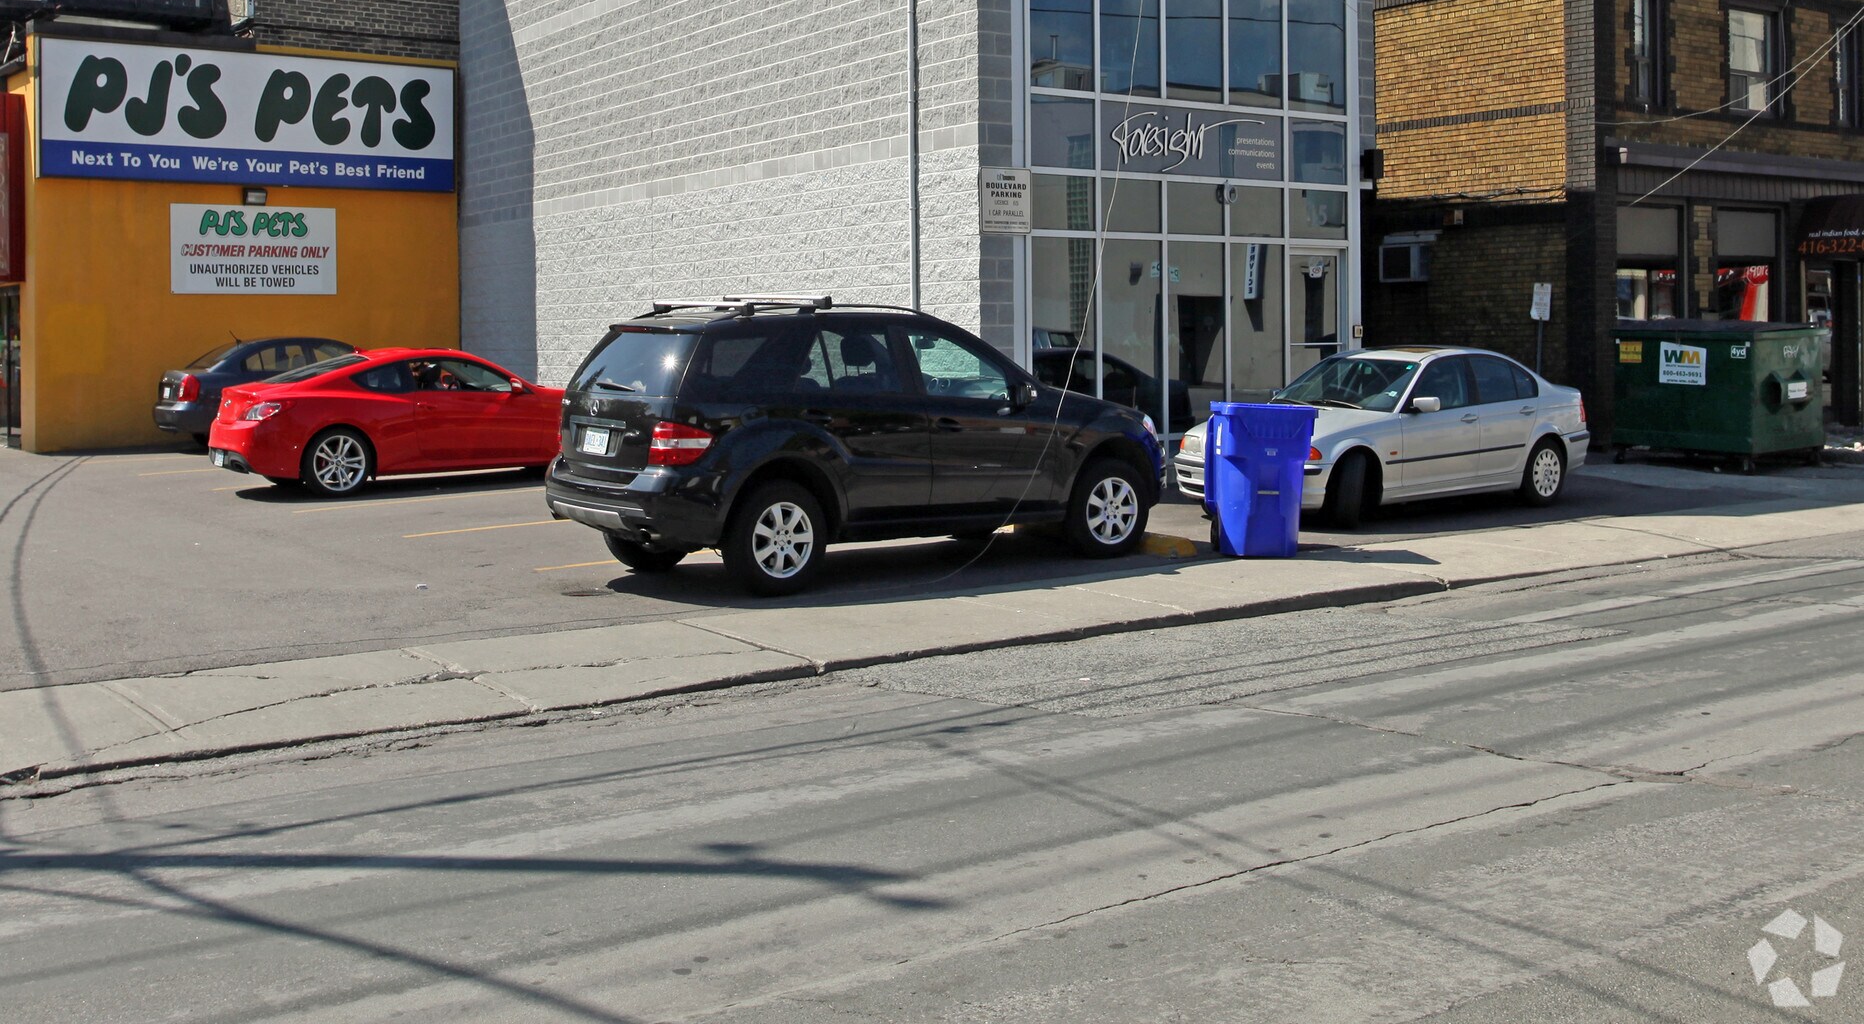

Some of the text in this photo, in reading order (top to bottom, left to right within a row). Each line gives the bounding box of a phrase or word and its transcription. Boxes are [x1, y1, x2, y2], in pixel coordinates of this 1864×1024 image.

[63, 53, 436, 151] PJ'S PETS
[1111, 111, 1266, 173] Foresight
[1236, 136, 1275, 147] presentations
[1227, 148, 1275, 158] communications
[71, 150, 425, 179] Next To You We're Your Pet's Best Friend
[1256, 161, 1275, 170] events
[985, 182, 1027, 190] BOULEVARD
[199, 209, 309, 238] PJ'S PETS
[1808, 230, 1821, 238] real
[1821, 229, 1843, 237] indian
[181, 244, 330, 259] CUSTOMER PARKING ONLY
[189, 263, 319, 275] UNAUTHORIZED VEHICLES
[215, 277, 295, 288] WILL BE TOWED
[1664, 349, 1701, 365] WM
[1731, 346, 1746, 357] 4yd
